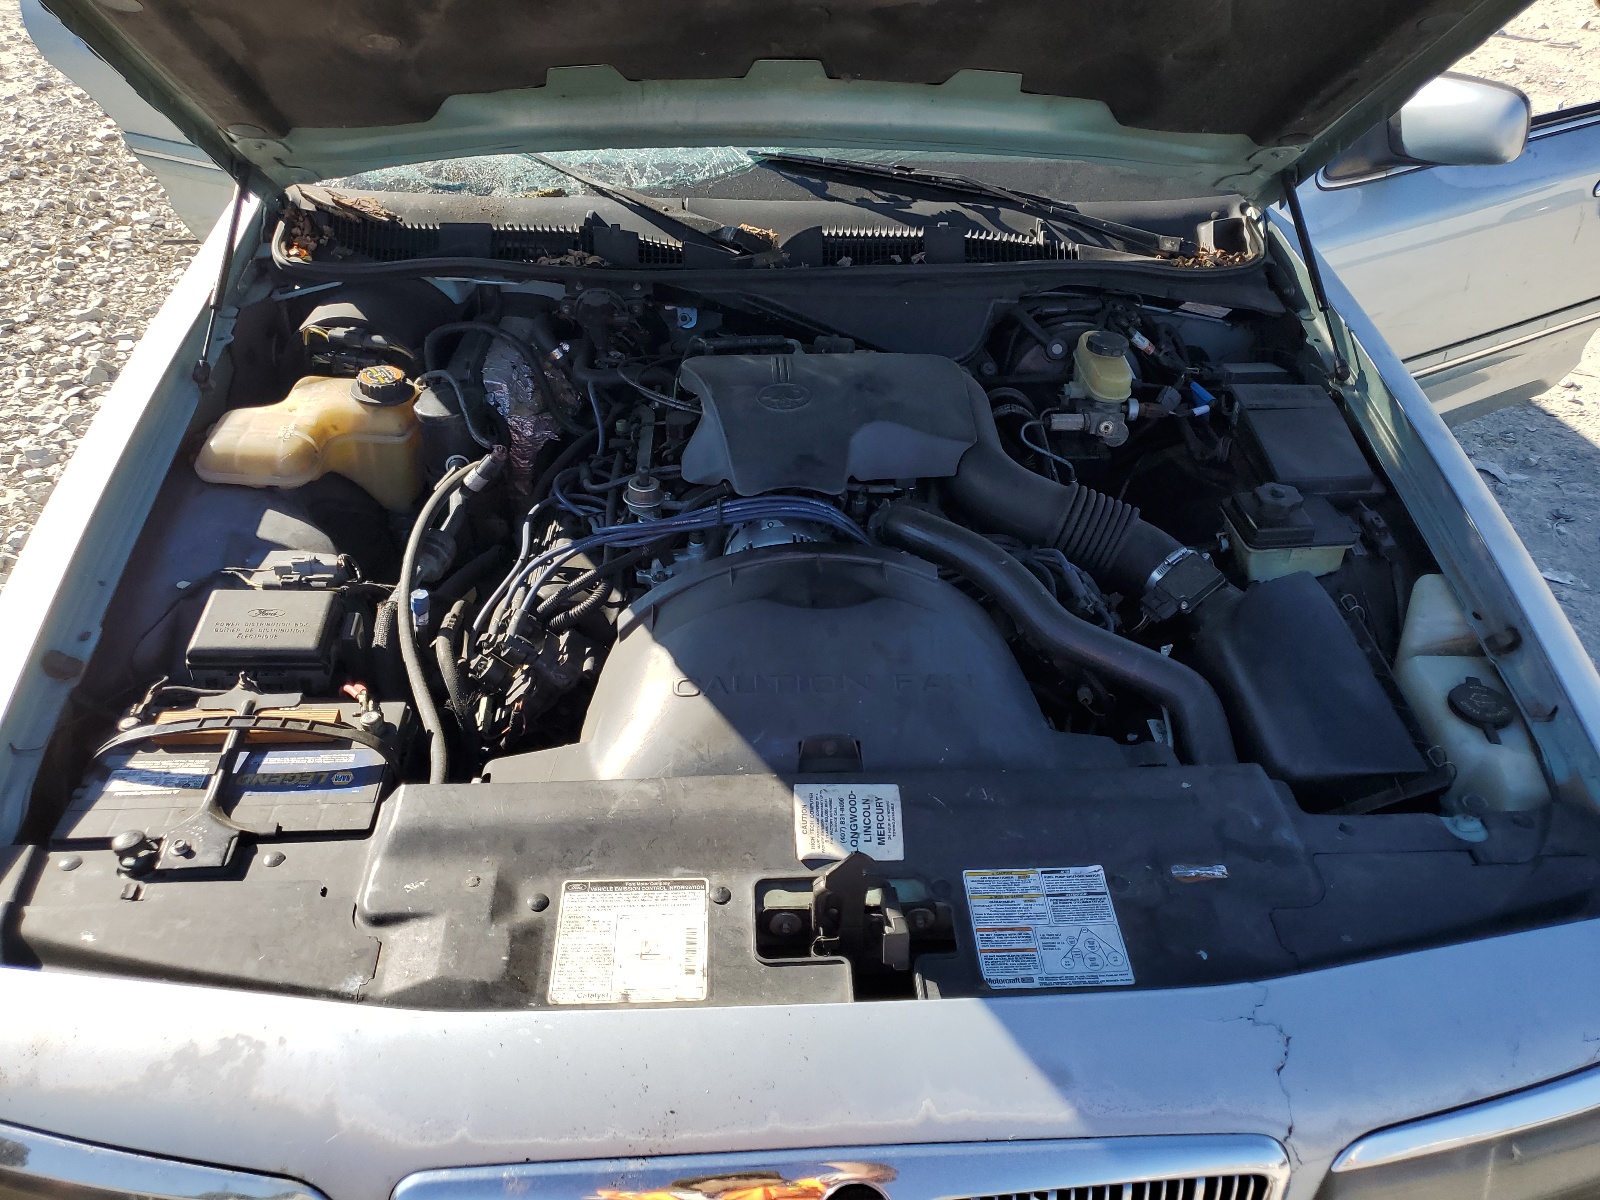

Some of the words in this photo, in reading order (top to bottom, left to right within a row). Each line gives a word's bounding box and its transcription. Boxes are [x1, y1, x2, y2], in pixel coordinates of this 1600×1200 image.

[673, 674, 872, 697] CAUTION
[237, 772, 330, 786] LEGEND
[862, 798, 872, 842] LINCOLN
[875, 796, 885, 845] MERCURY
